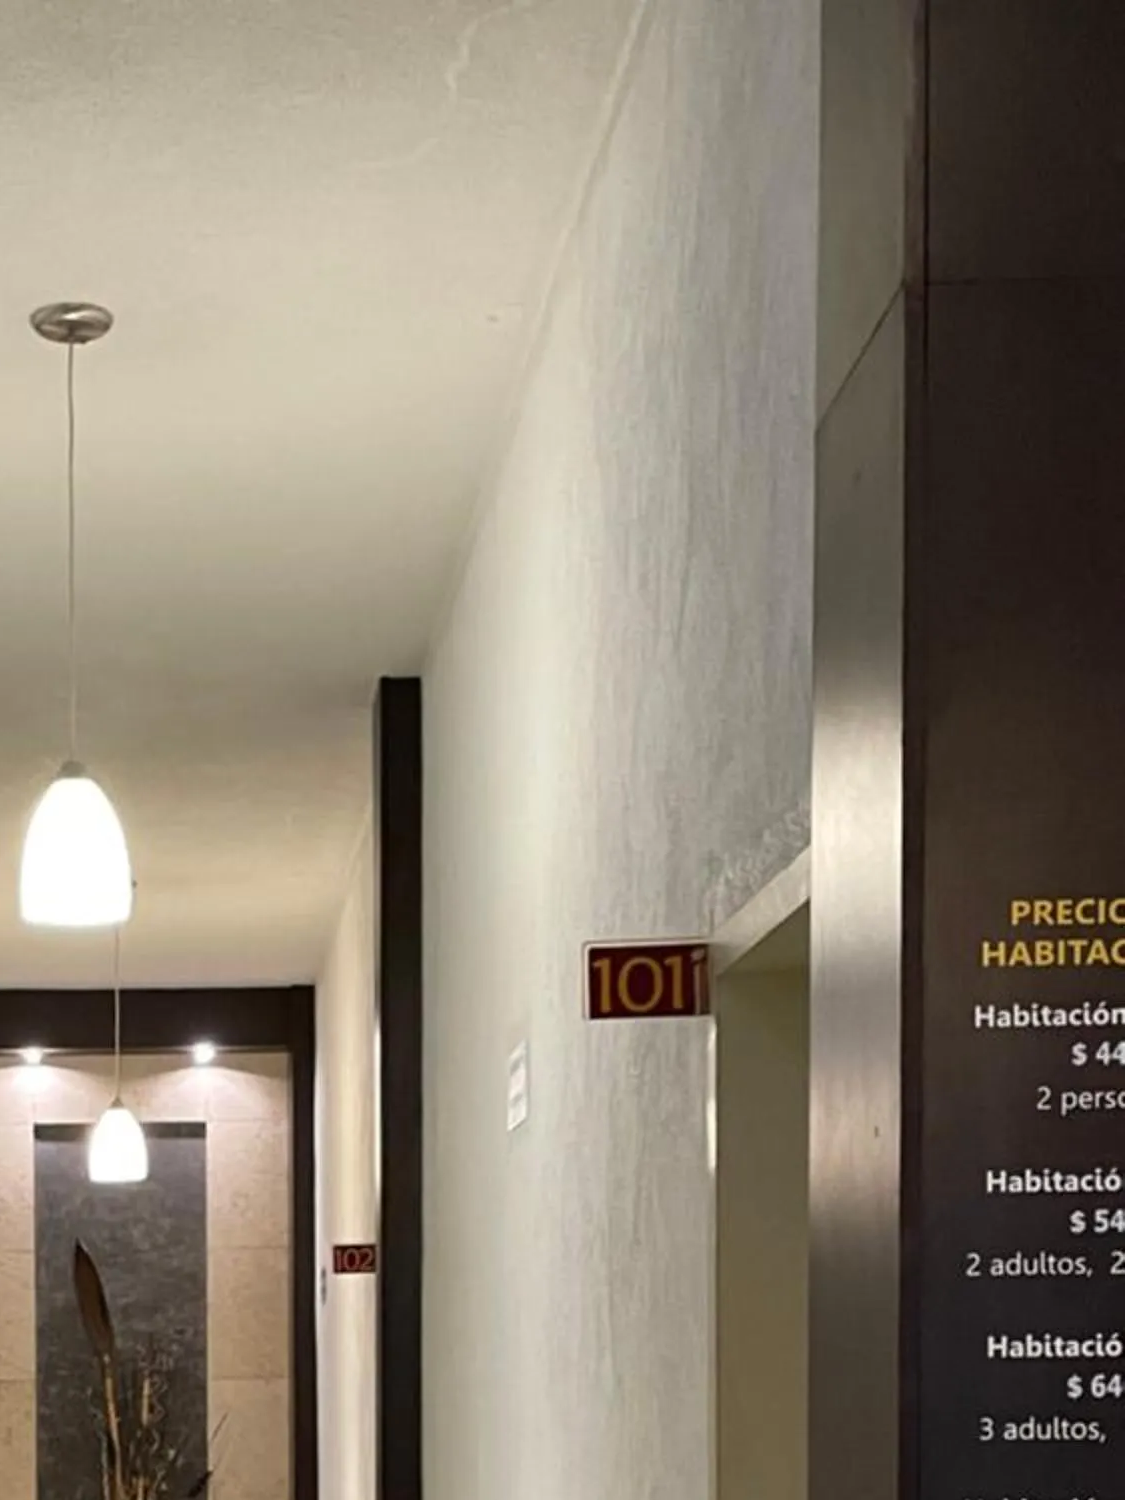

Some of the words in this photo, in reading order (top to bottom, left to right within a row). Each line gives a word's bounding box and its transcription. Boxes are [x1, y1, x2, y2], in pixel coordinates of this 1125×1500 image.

[983, 939, 1125, 967] HABITAC
[975, 1002, 1125, 1028] Habitación
[1037, 1086, 1051, 1110] 2
[987, 1168, 1121, 1192] Habitació
[336, 1248, 373, 1272] 102
[966, 1253, 980, 1276] 2
[990, 1252, 1092, 1276] adultos,
[1110, 1251, 1125, 1274] 2
[988, 1333, 1122, 1358] Habitació
[980, 1418, 994, 1440] 3
[1003, 1416, 1105, 1442] adultos,
